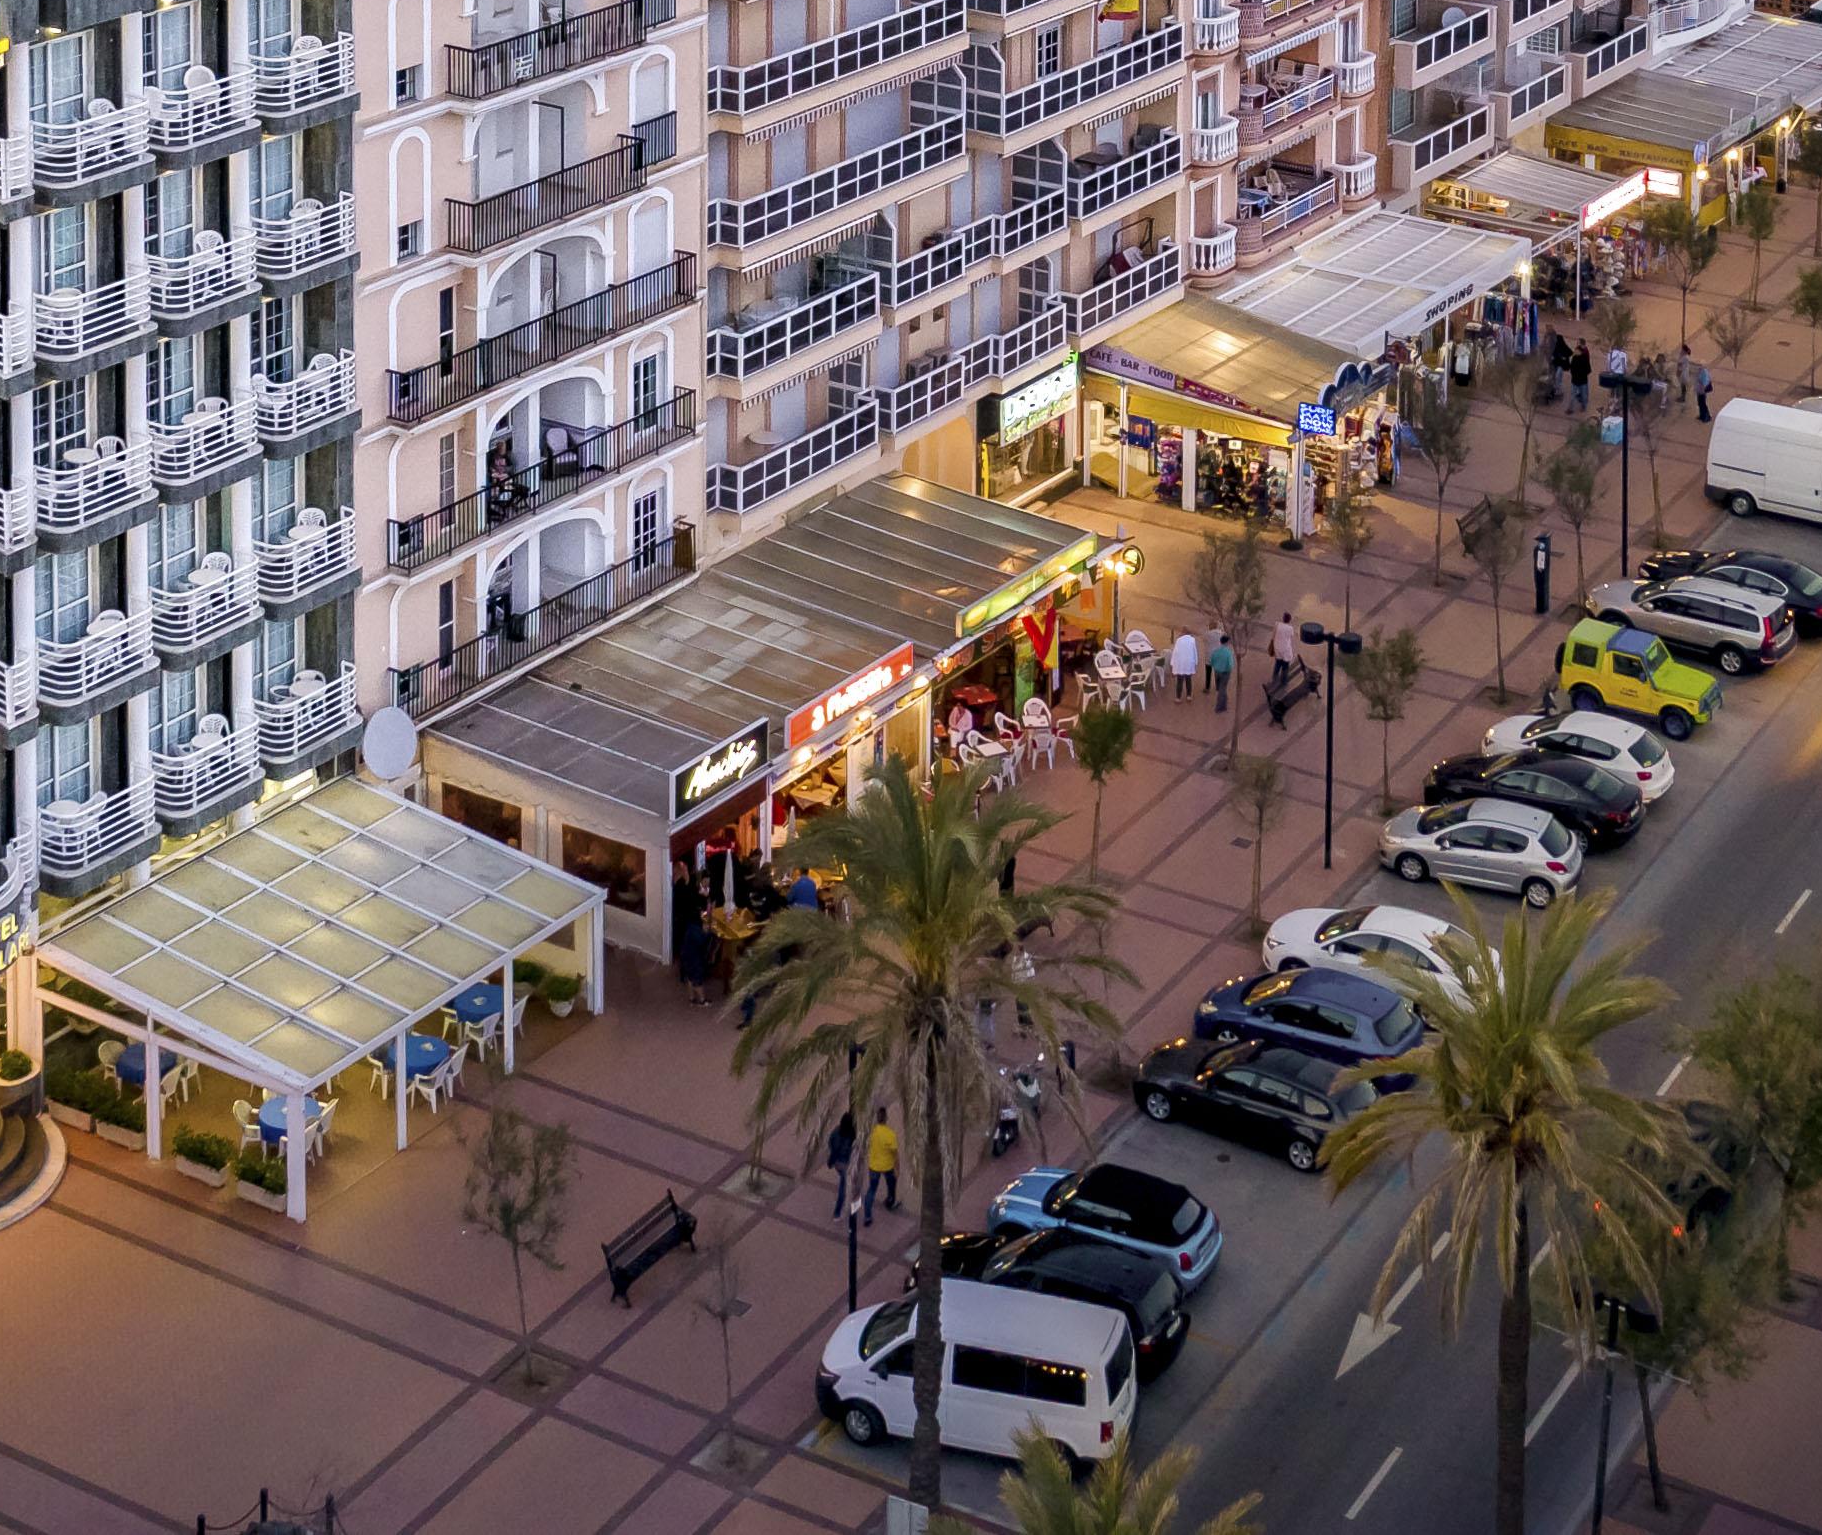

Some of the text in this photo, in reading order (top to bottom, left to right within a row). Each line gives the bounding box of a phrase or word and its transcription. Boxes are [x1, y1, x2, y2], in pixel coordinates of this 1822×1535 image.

[1424, 283, 1475, 323] SHOPING
[1120, 357, 1140, 372] BAR
[1148, 365, 1174, 382] FOOD
